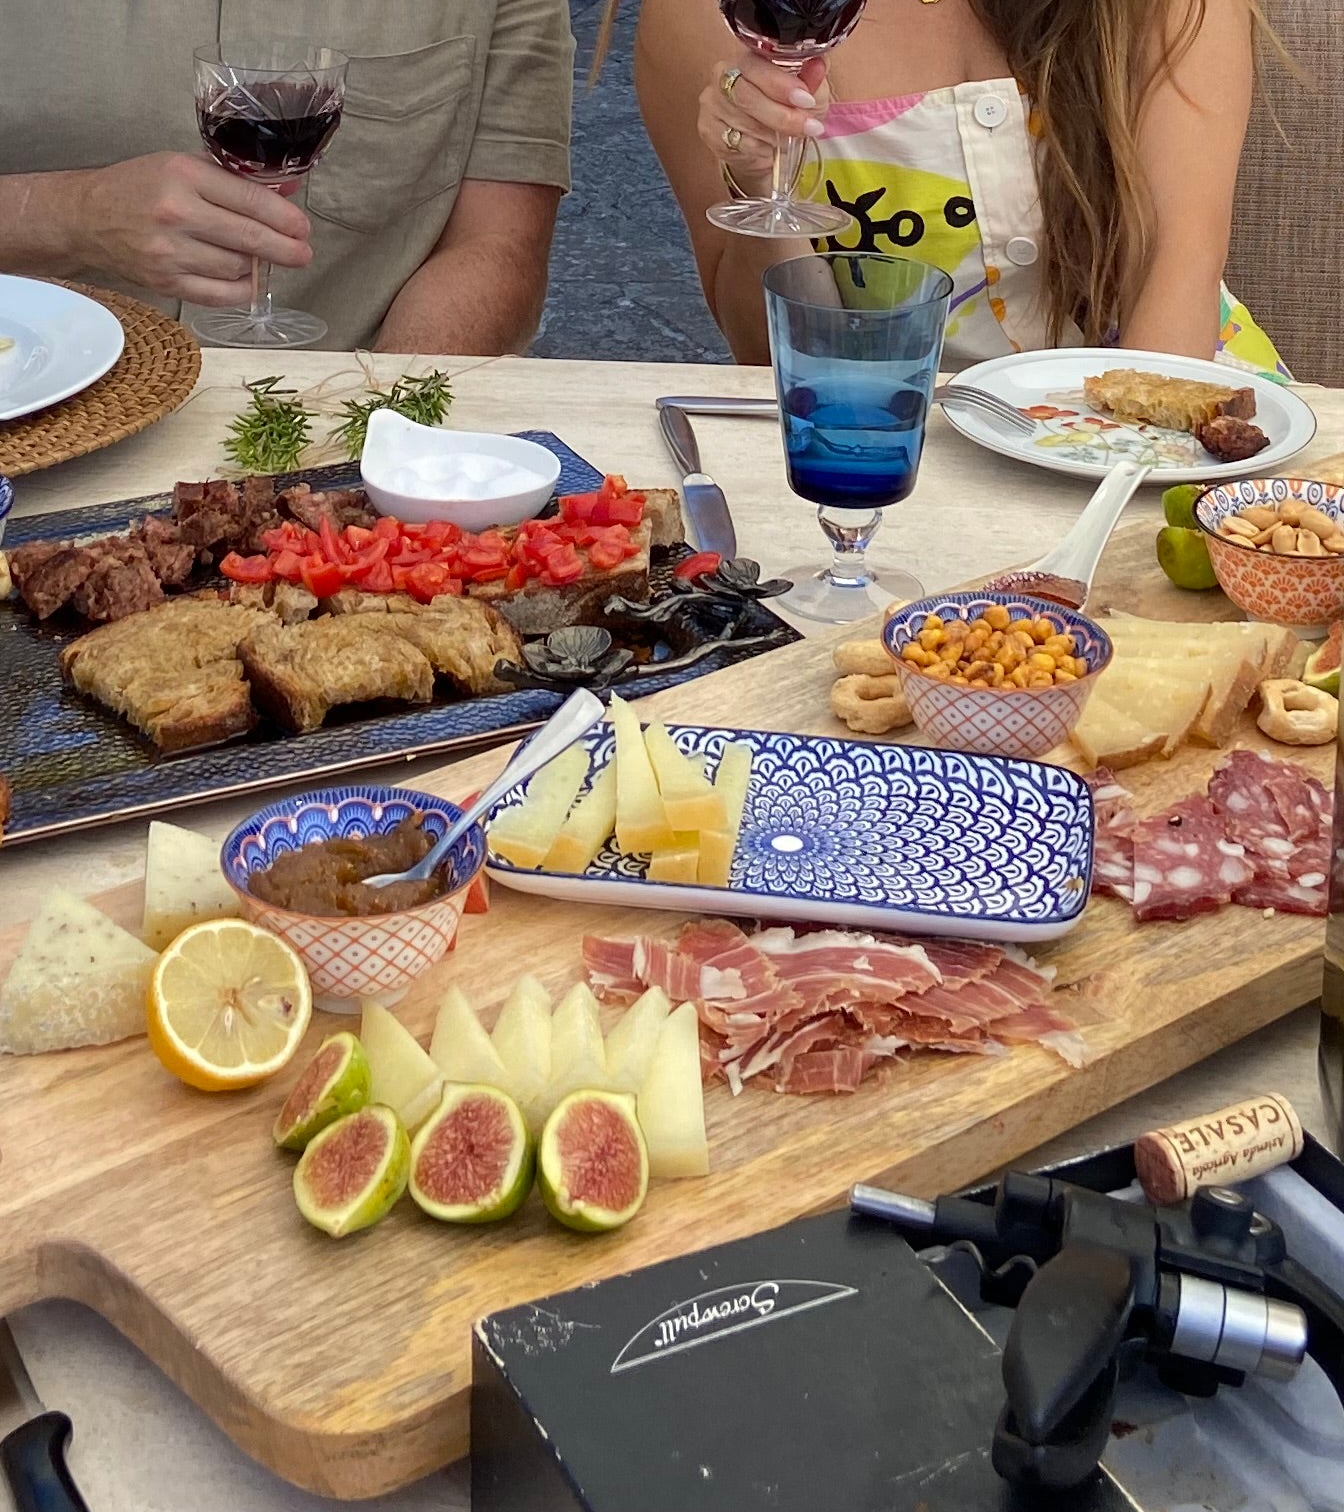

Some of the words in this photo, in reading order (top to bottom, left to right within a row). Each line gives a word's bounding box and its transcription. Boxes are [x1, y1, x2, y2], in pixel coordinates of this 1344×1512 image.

[1175, 1103, 1281, 1154] CASALE
[1243, 1134, 1286, 1163] Azienda
[1192, 1150, 1239, 1181] Agricola
[658, 1281, 780, 1345] Screwpull
